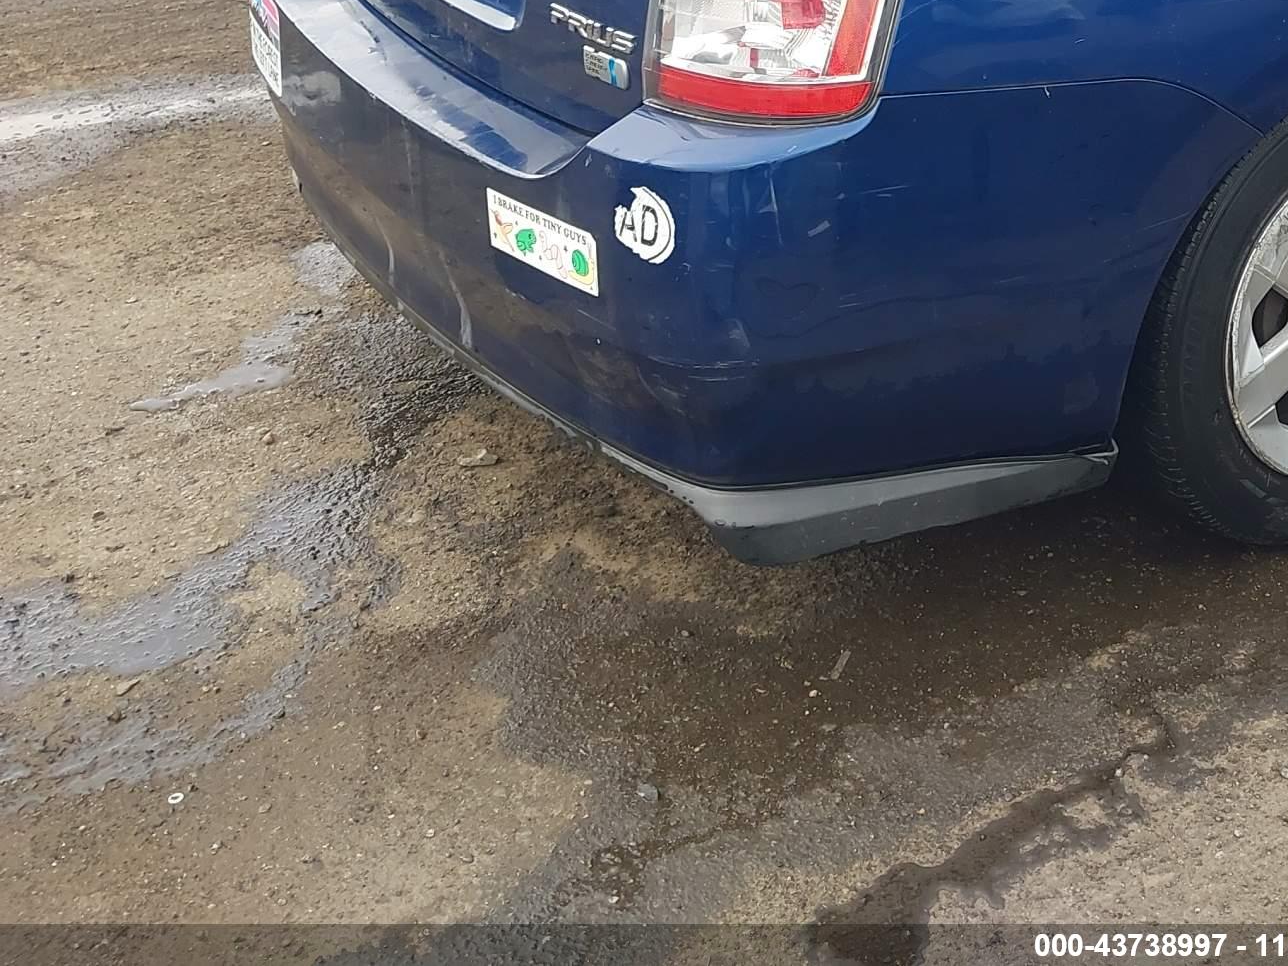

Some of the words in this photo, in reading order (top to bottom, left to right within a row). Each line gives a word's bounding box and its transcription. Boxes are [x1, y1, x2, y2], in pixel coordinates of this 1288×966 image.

[549, 2, 638, 55] PRIUS
[497, 196, 524, 219] BRAKE
[525, 209, 541, 225] FOR
[542, 217, 563, 235] TINY
[563, 226, 588, 246] GUYS
